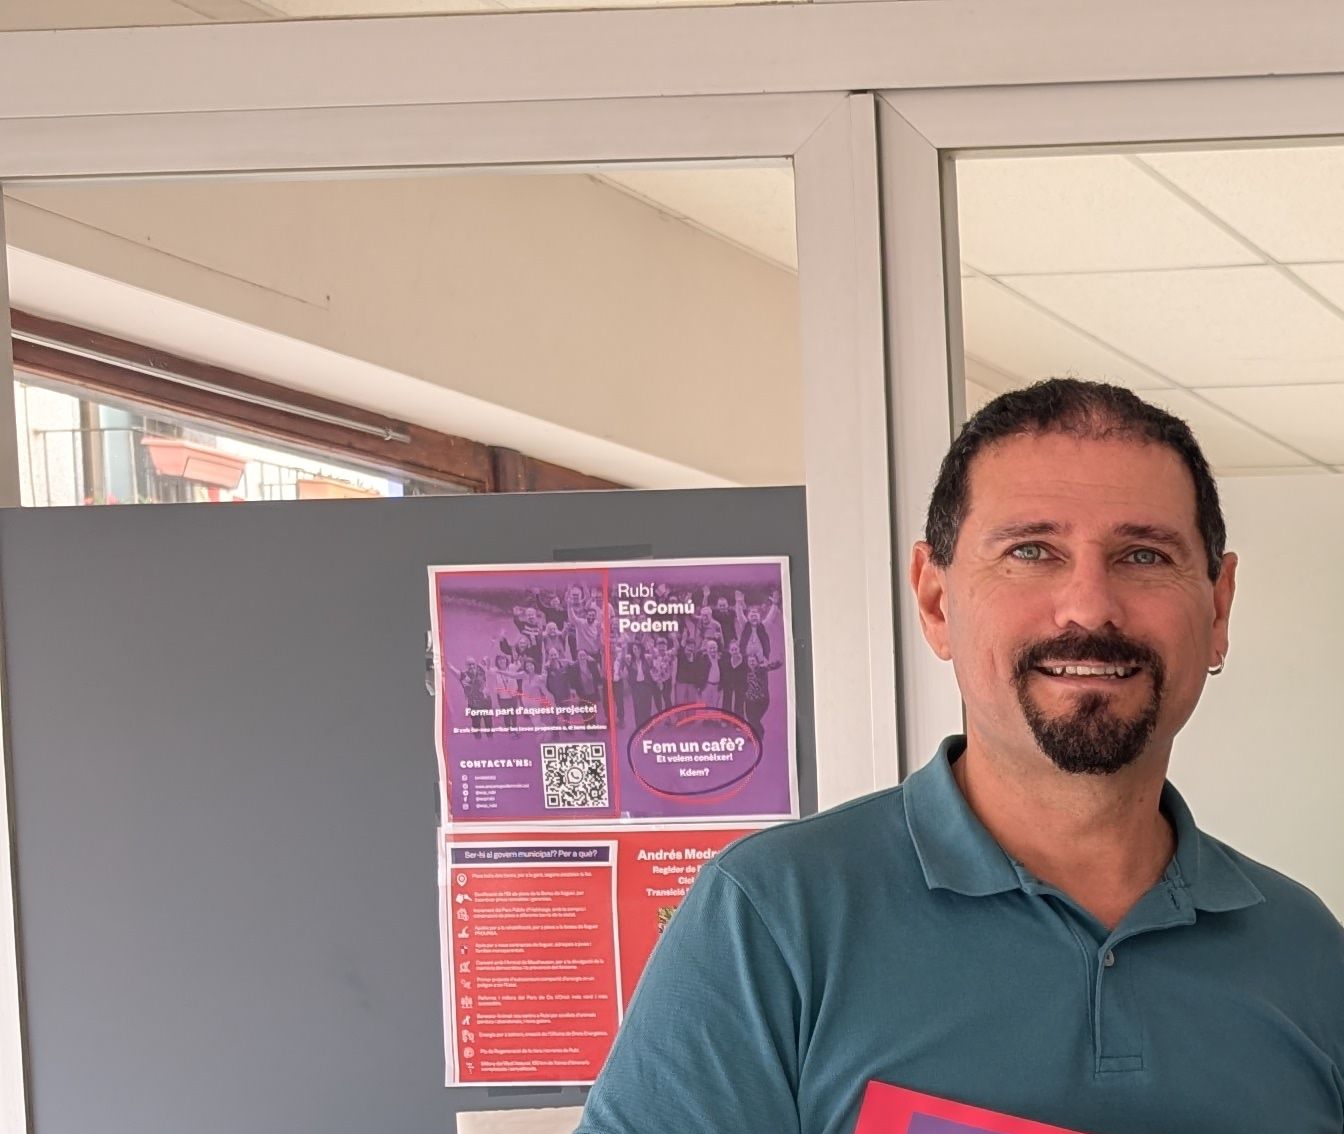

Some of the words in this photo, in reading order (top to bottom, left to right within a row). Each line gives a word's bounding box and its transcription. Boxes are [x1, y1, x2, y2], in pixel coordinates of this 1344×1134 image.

[618, 582, 654, 597] Rubí
[618, 602, 640, 615] En
[644, 600, 694, 614] Comú
[619, 618, 678, 632] Podem
[643, 740, 676, 753] Fem
[680, 742, 700, 752] un
[638, 849, 682, 860] Andrés
